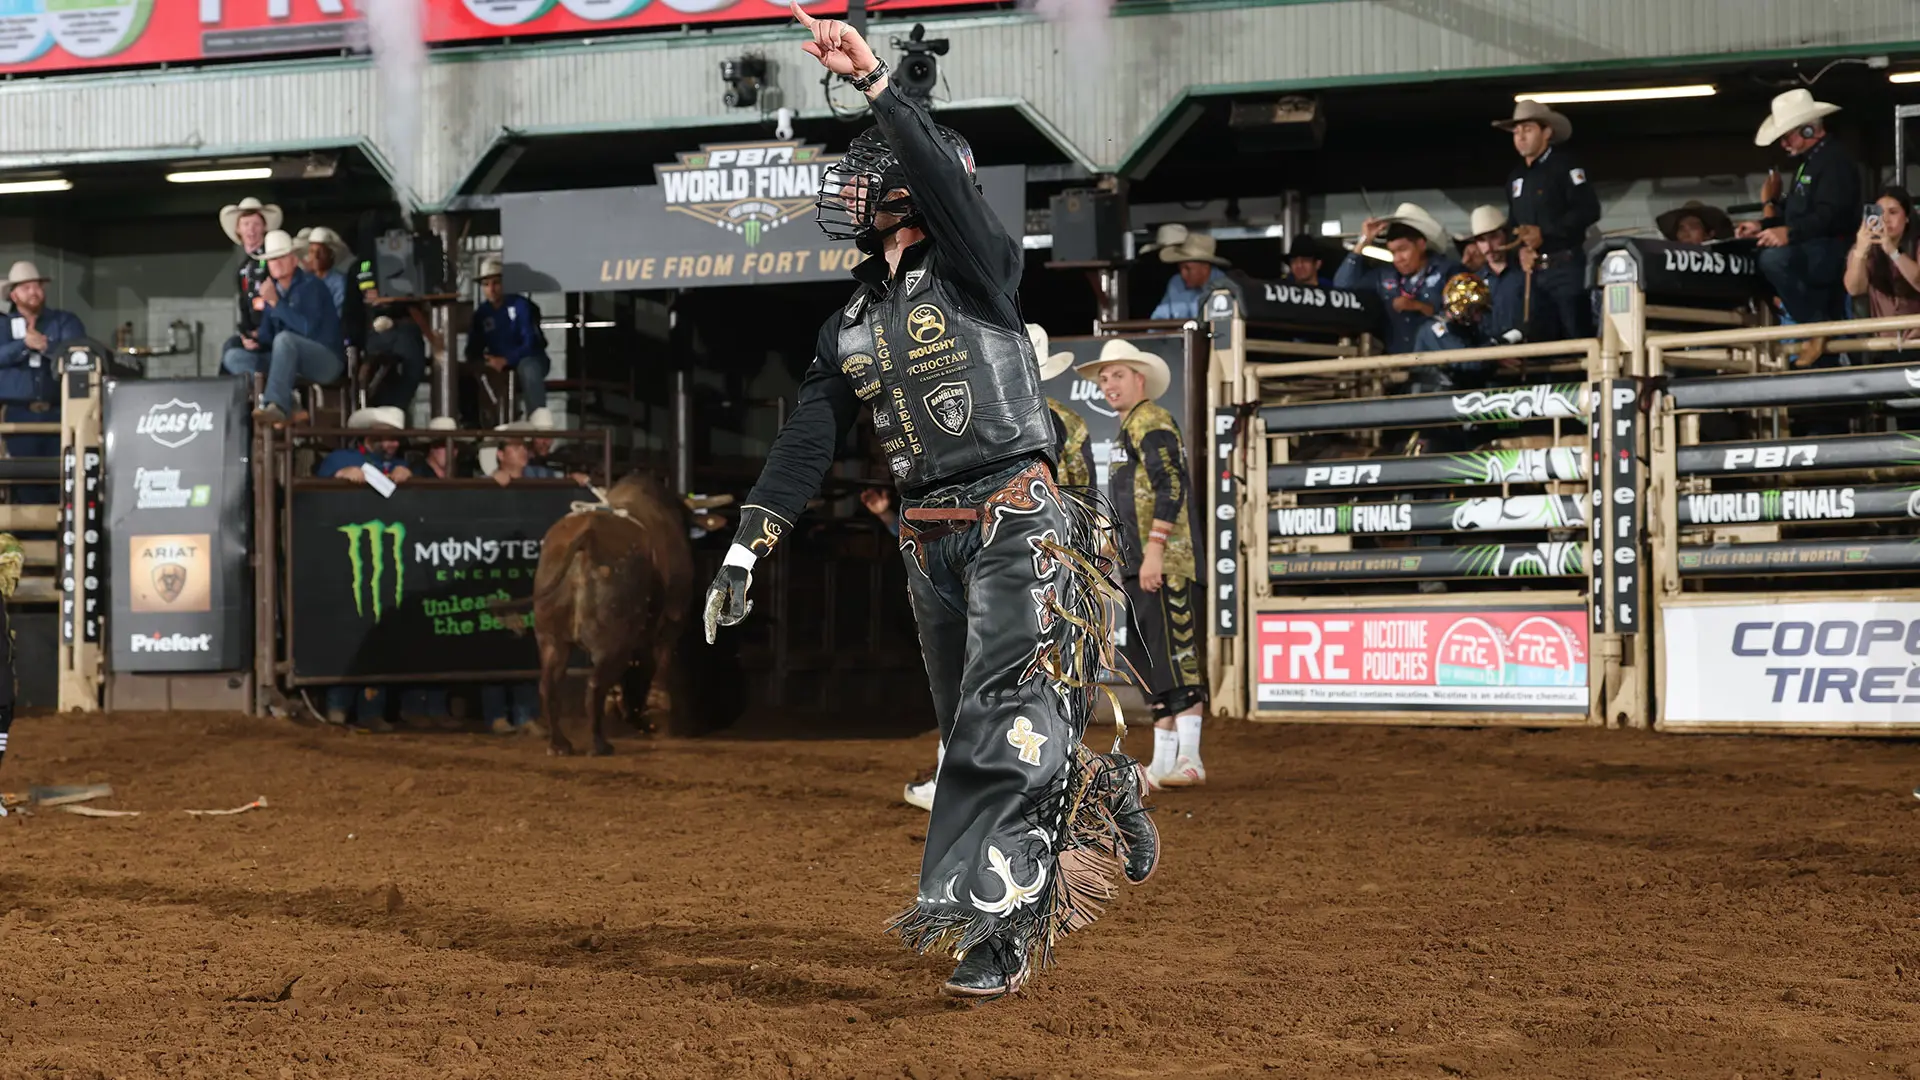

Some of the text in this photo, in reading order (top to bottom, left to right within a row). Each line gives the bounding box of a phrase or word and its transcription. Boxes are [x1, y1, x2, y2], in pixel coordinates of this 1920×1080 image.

[662, 168, 749, 203] WORLD
[601, 258, 655, 282] LIVE
[663, 254, 735, 278] FROM
[742, 250, 810, 275] FORT
[1664, 249, 1725, 274] LUCAS
[1264, 284, 1362, 309] LUCAS OIL
[874, 325, 893, 372] SAGE
[908, 337, 956, 360] ROUGHY
[911, 350, 968, 375] CHOCTAW
[930, 388, 964, 406] GAMBLERS
[136, 412, 213, 433] LUCAS OIL
[892, 387, 922, 455] STEELE
[1278, 504, 1411, 535] WORLD FINALS
[1612, 387, 1636, 624] Priefert
[1688, 488, 1855, 524] WORLD FINALS
[1215, 414, 1236, 628] Priefert
[84, 453, 99, 637] Priefert
[142, 546, 198, 559] ARIAT
[414, 536, 544, 567] MONSTE
[1703, 553, 1728, 565] LIVE
[1731, 551, 1763, 564] FROM
[1766, 550, 1795, 562] FORT
[1799, 549, 1840, 562] WORTH
[436, 568, 536, 581] ENERGY
[1289, 561, 1308, 573] LIVE
[1310, 560, 1337, 572] FROM
[1339, 559, 1364, 571] FORT
[1365, 558, 1399, 571] WORTH
[434, 616, 474, 635] the
[1363, 619, 1428, 649] NICOTINE
[131, 632, 212, 652] Priefert
[1262, 620, 1350, 680] FRE
[1450, 633, 1492, 665] FRE
[1517, 632, 1560, 665] FRE
[1363, 652, 1428, 681] POUCHES
[1310, 688, 1326, 698] This
[1328, 689, 1357, 700] product
[1360, 690, 1393, 698] contains
[1433, 691, 1467, 700] Nicotine
[1471, 691, 1477, 700] is
[1493, 691, 1533, 700] addictive
